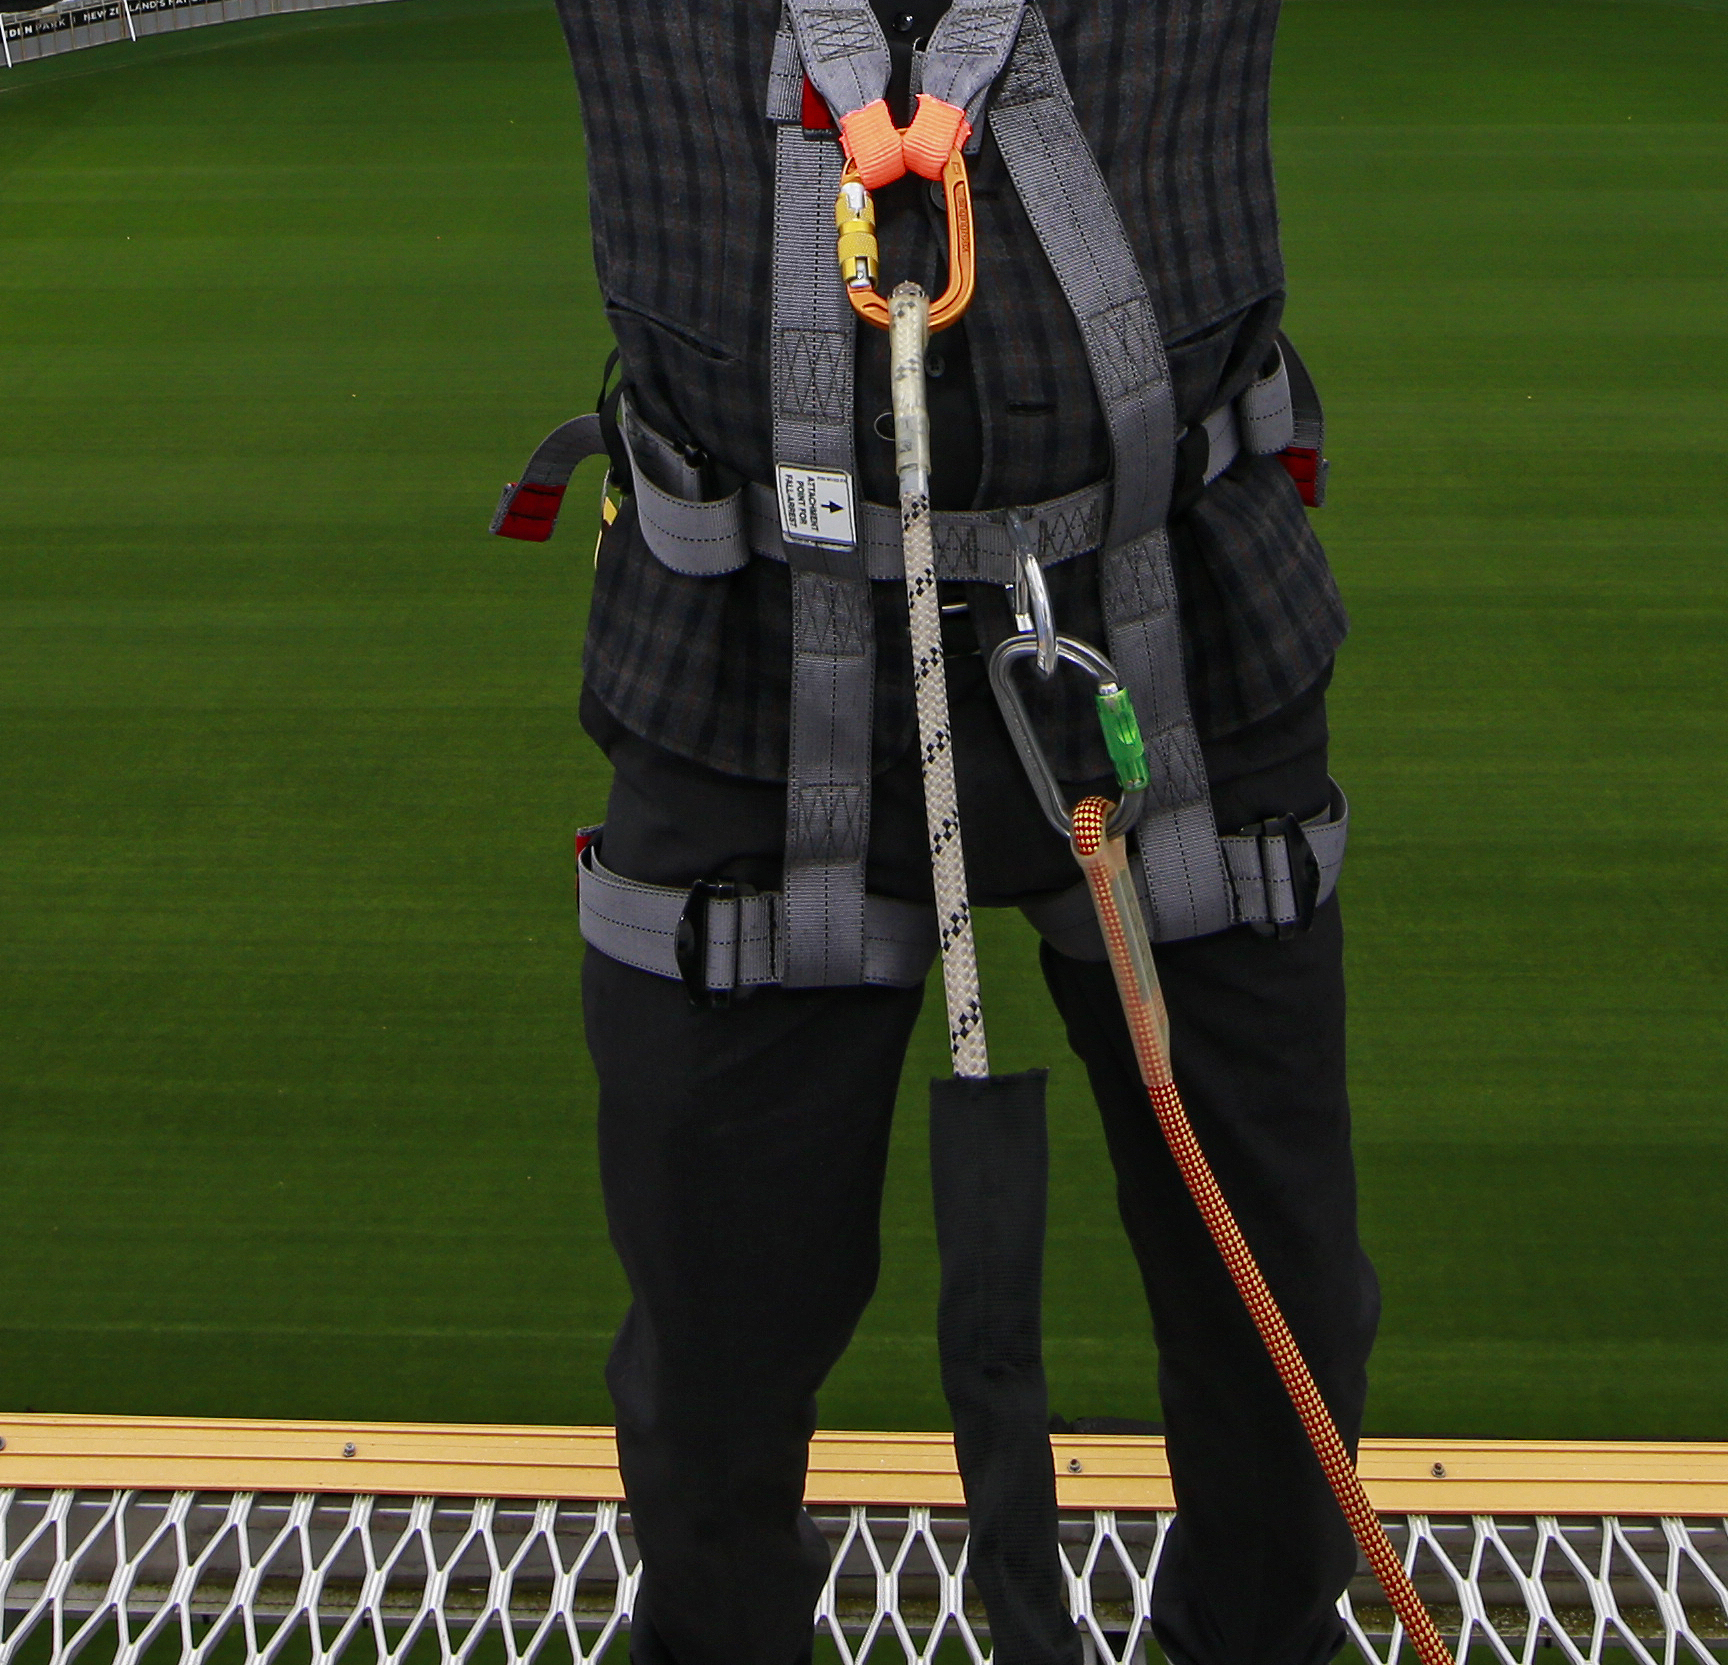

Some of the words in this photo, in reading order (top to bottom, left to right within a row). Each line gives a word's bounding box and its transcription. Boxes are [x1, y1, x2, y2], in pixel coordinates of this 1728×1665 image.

[4, 25, 32, 39] DN
[83, 11, 106, 21] NEW
[109, 0, 165, 16] ZLAND'S
[797, 481, 805, 506] POINT
[808, 476, 818, 531] ATTACHMENT
